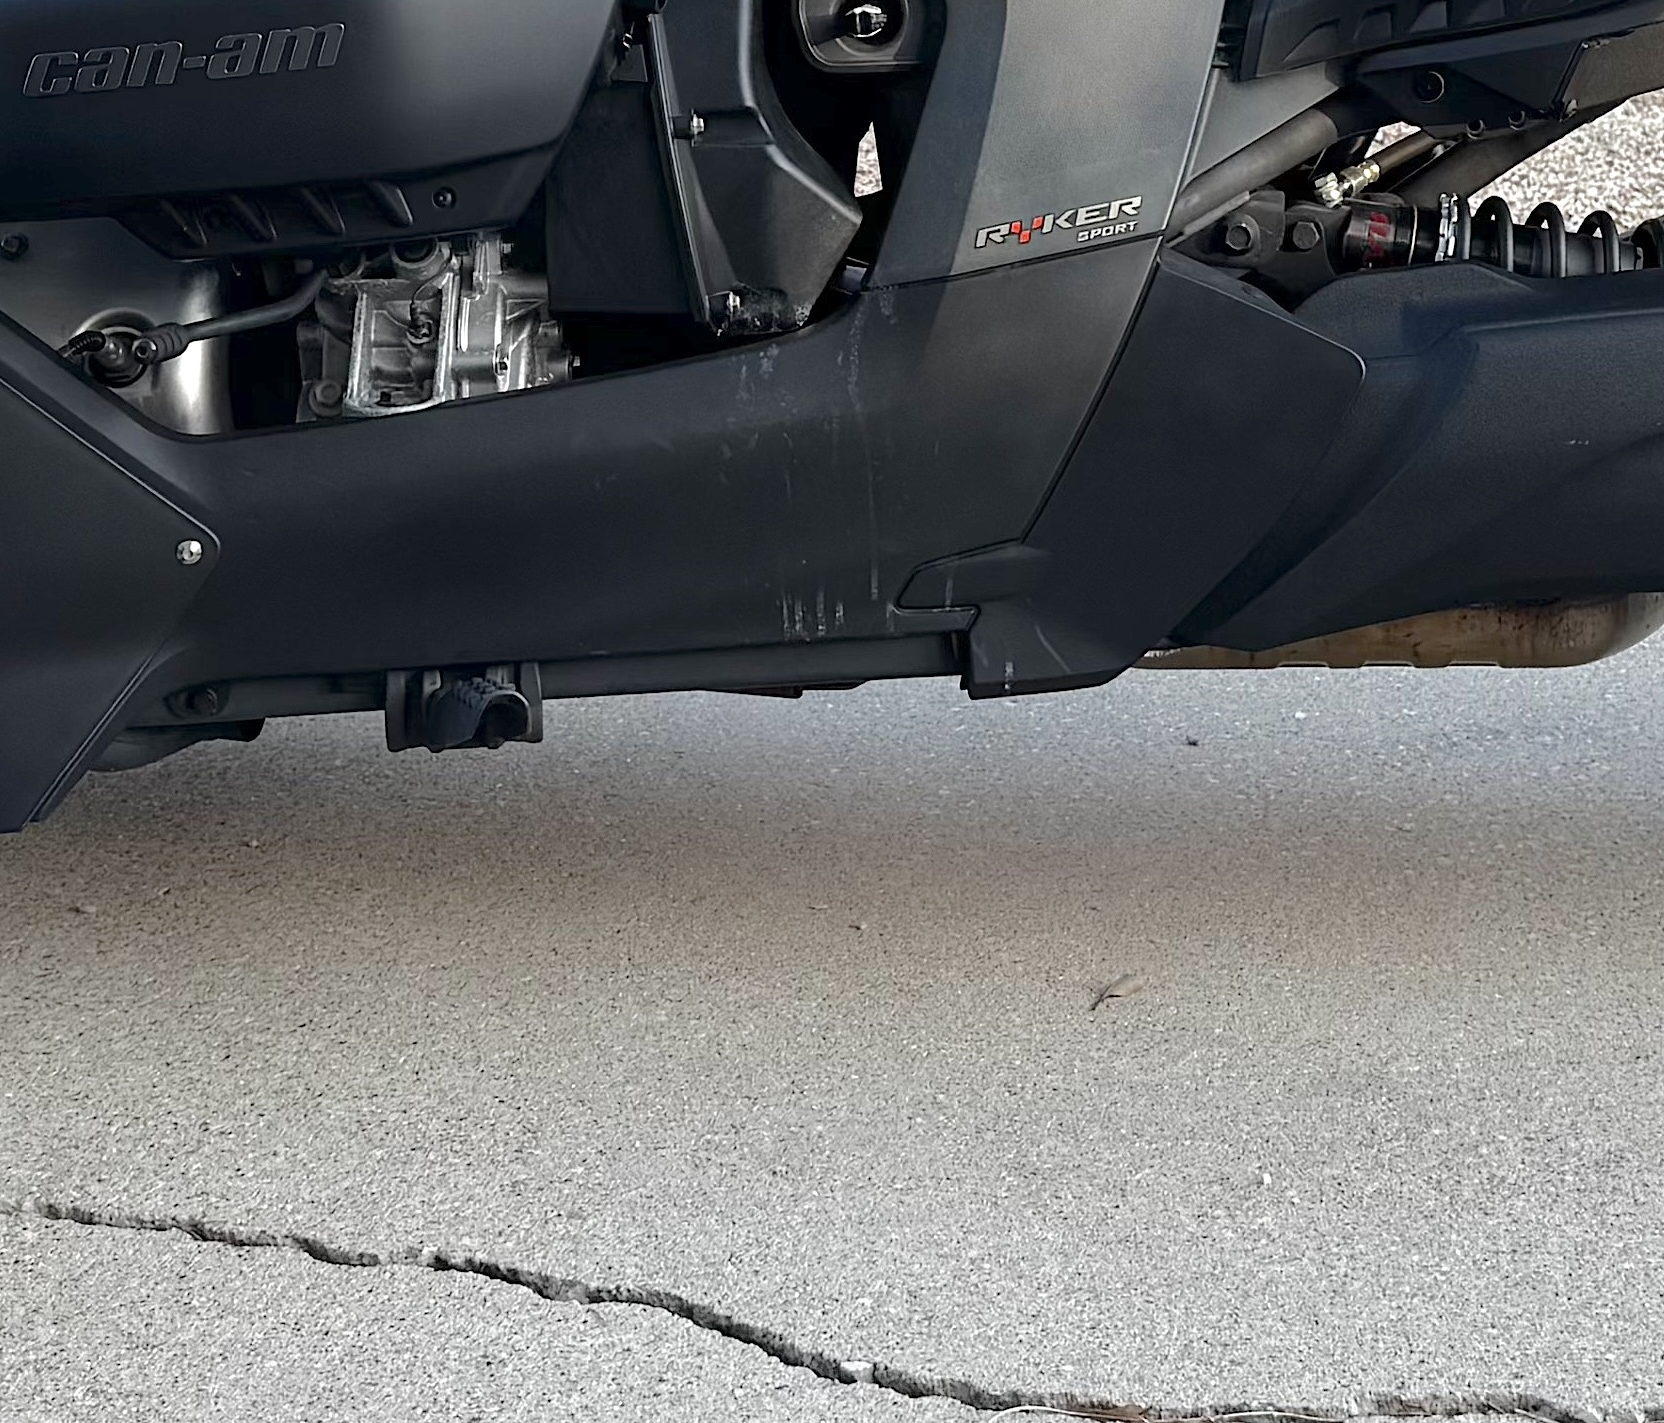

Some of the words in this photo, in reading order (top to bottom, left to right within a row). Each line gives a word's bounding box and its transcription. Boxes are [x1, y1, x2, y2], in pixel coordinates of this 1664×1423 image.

[22, 22, 345, 98] can-am
[974, 195, 1143, 248] RYKER
[1077, 220, 1139, 243] SPORT
